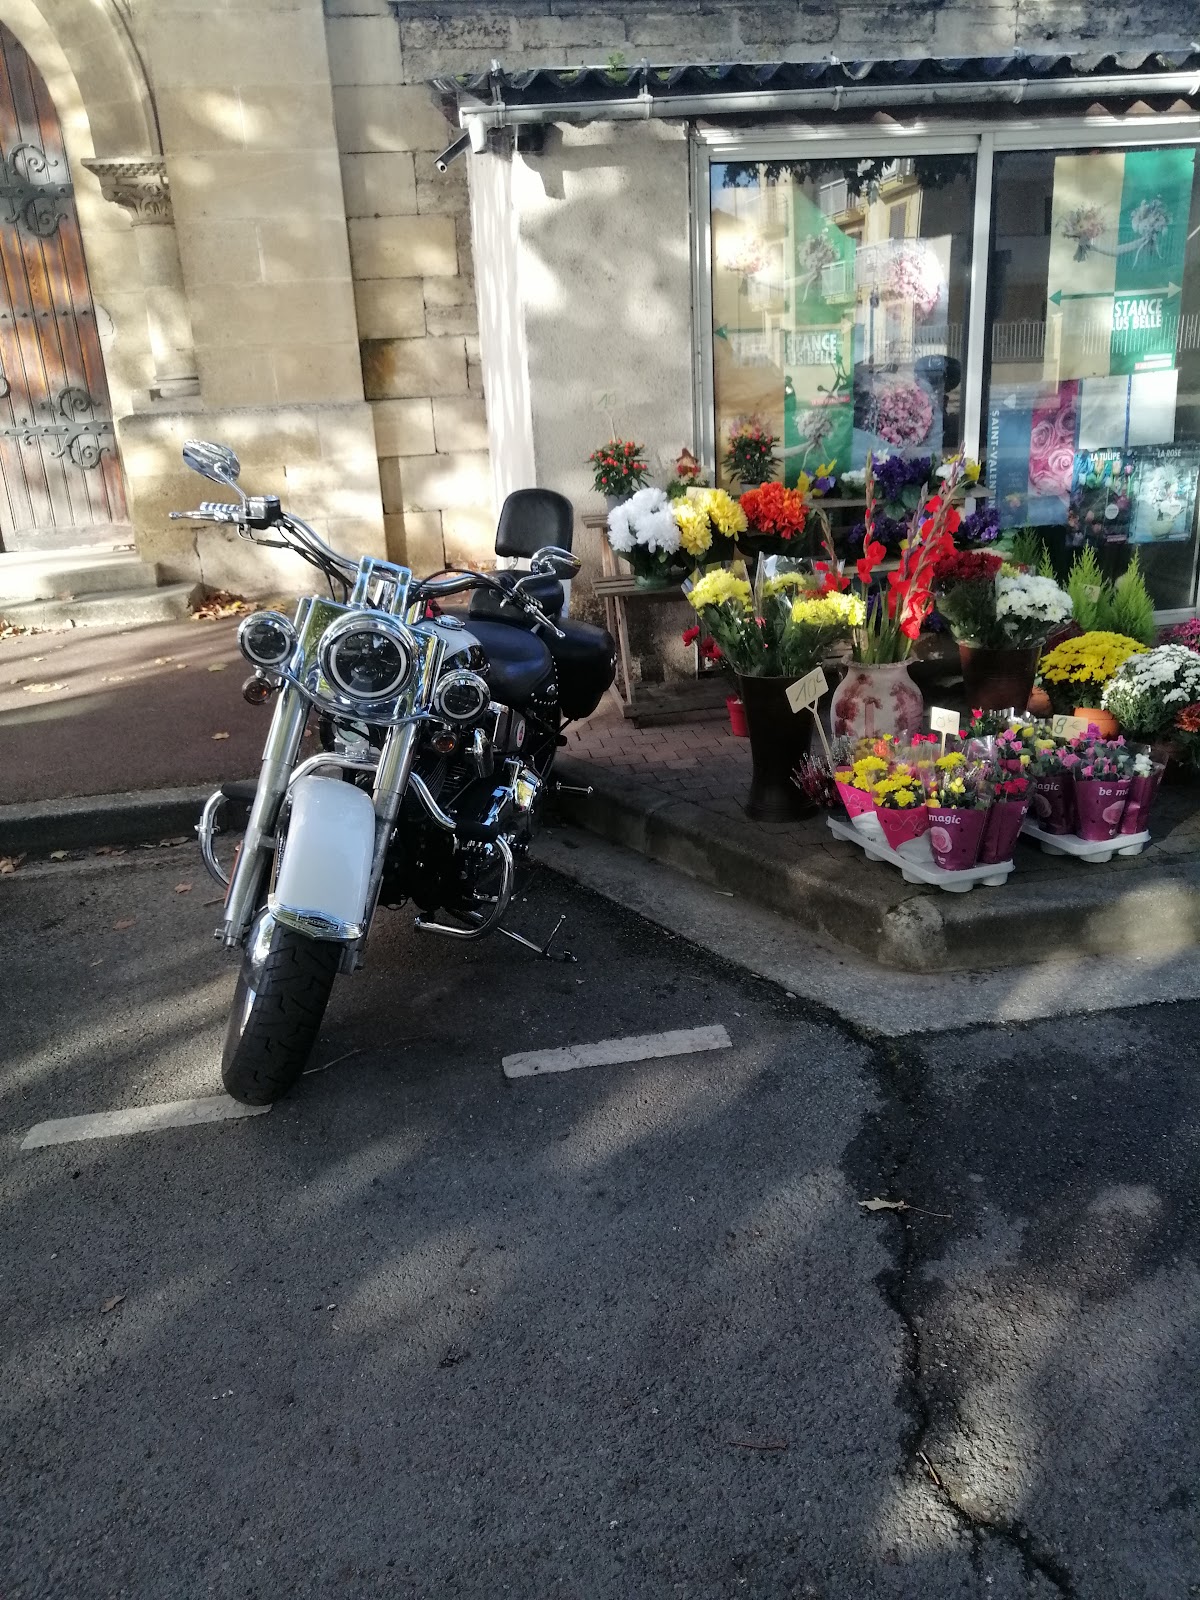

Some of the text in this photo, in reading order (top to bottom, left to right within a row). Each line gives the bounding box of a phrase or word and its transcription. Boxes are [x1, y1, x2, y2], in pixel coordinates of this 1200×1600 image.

[1132, 314, 1161, 330] BELLE
[807, 349, 837, 365] BELLE
[1091, 452, 1120, 461] LA TULIPE
[1157, 448, 1181, 458] LA ROSE
[1099, 787, 1112, 796] be
[928, 813, 962, 825] magic
